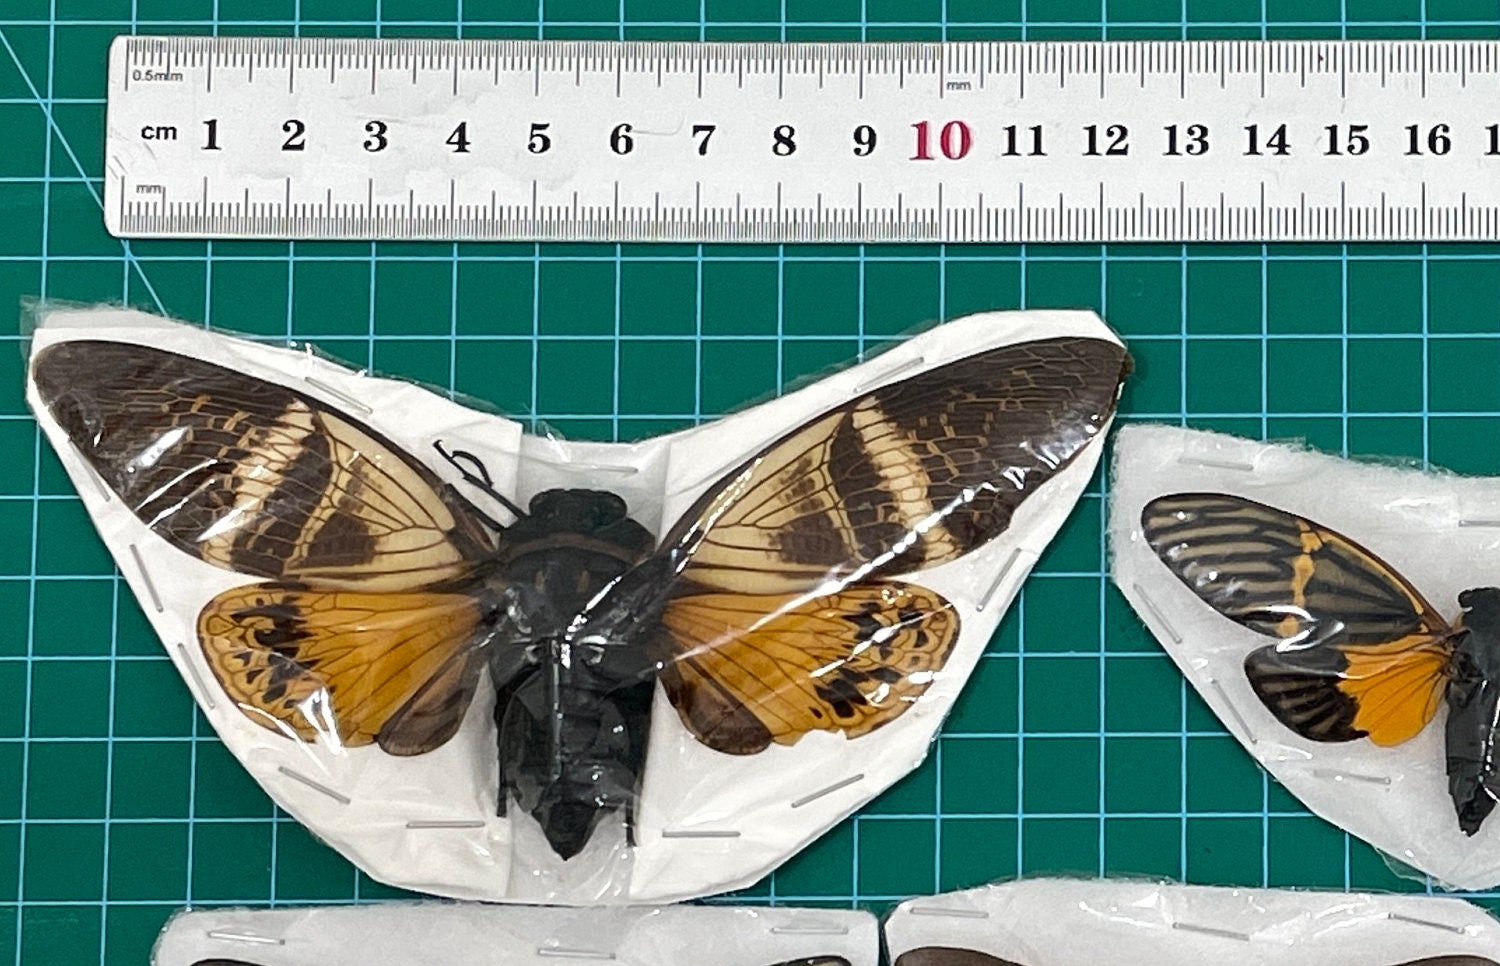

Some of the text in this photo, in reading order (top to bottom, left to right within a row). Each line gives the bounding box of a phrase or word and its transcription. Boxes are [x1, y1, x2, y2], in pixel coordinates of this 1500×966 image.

[132, 70, 182, 81] 0.5mm
[946, 80, 971, 90] mm
[141, 125, 177, 141] cm
[202, 119, 221, 150] 1
[281, 119, 306, 151] 2
[363, 120, 388, 153] 3
[445, 121, 471, 153] 4
[527, 123, 551, 154] 5
[610, 123, 634, 155] 6
[692, 124, 716, 156] 7
[772, 124, 797, 157] 8
[853, 124, 877, 157] 9
[910, 120, 971, 161] 10
[1002, 124, 1047, 157] 11
[1082, 124, 1129, 156] 12
[1163, 123, 1209, 156] 13
[1244, 123, 1291, 156] 14
[1324, 124, 1370, 156] 15
[1405, 123, 1451, 156] 16
[136, 184, 162, 194] mm
